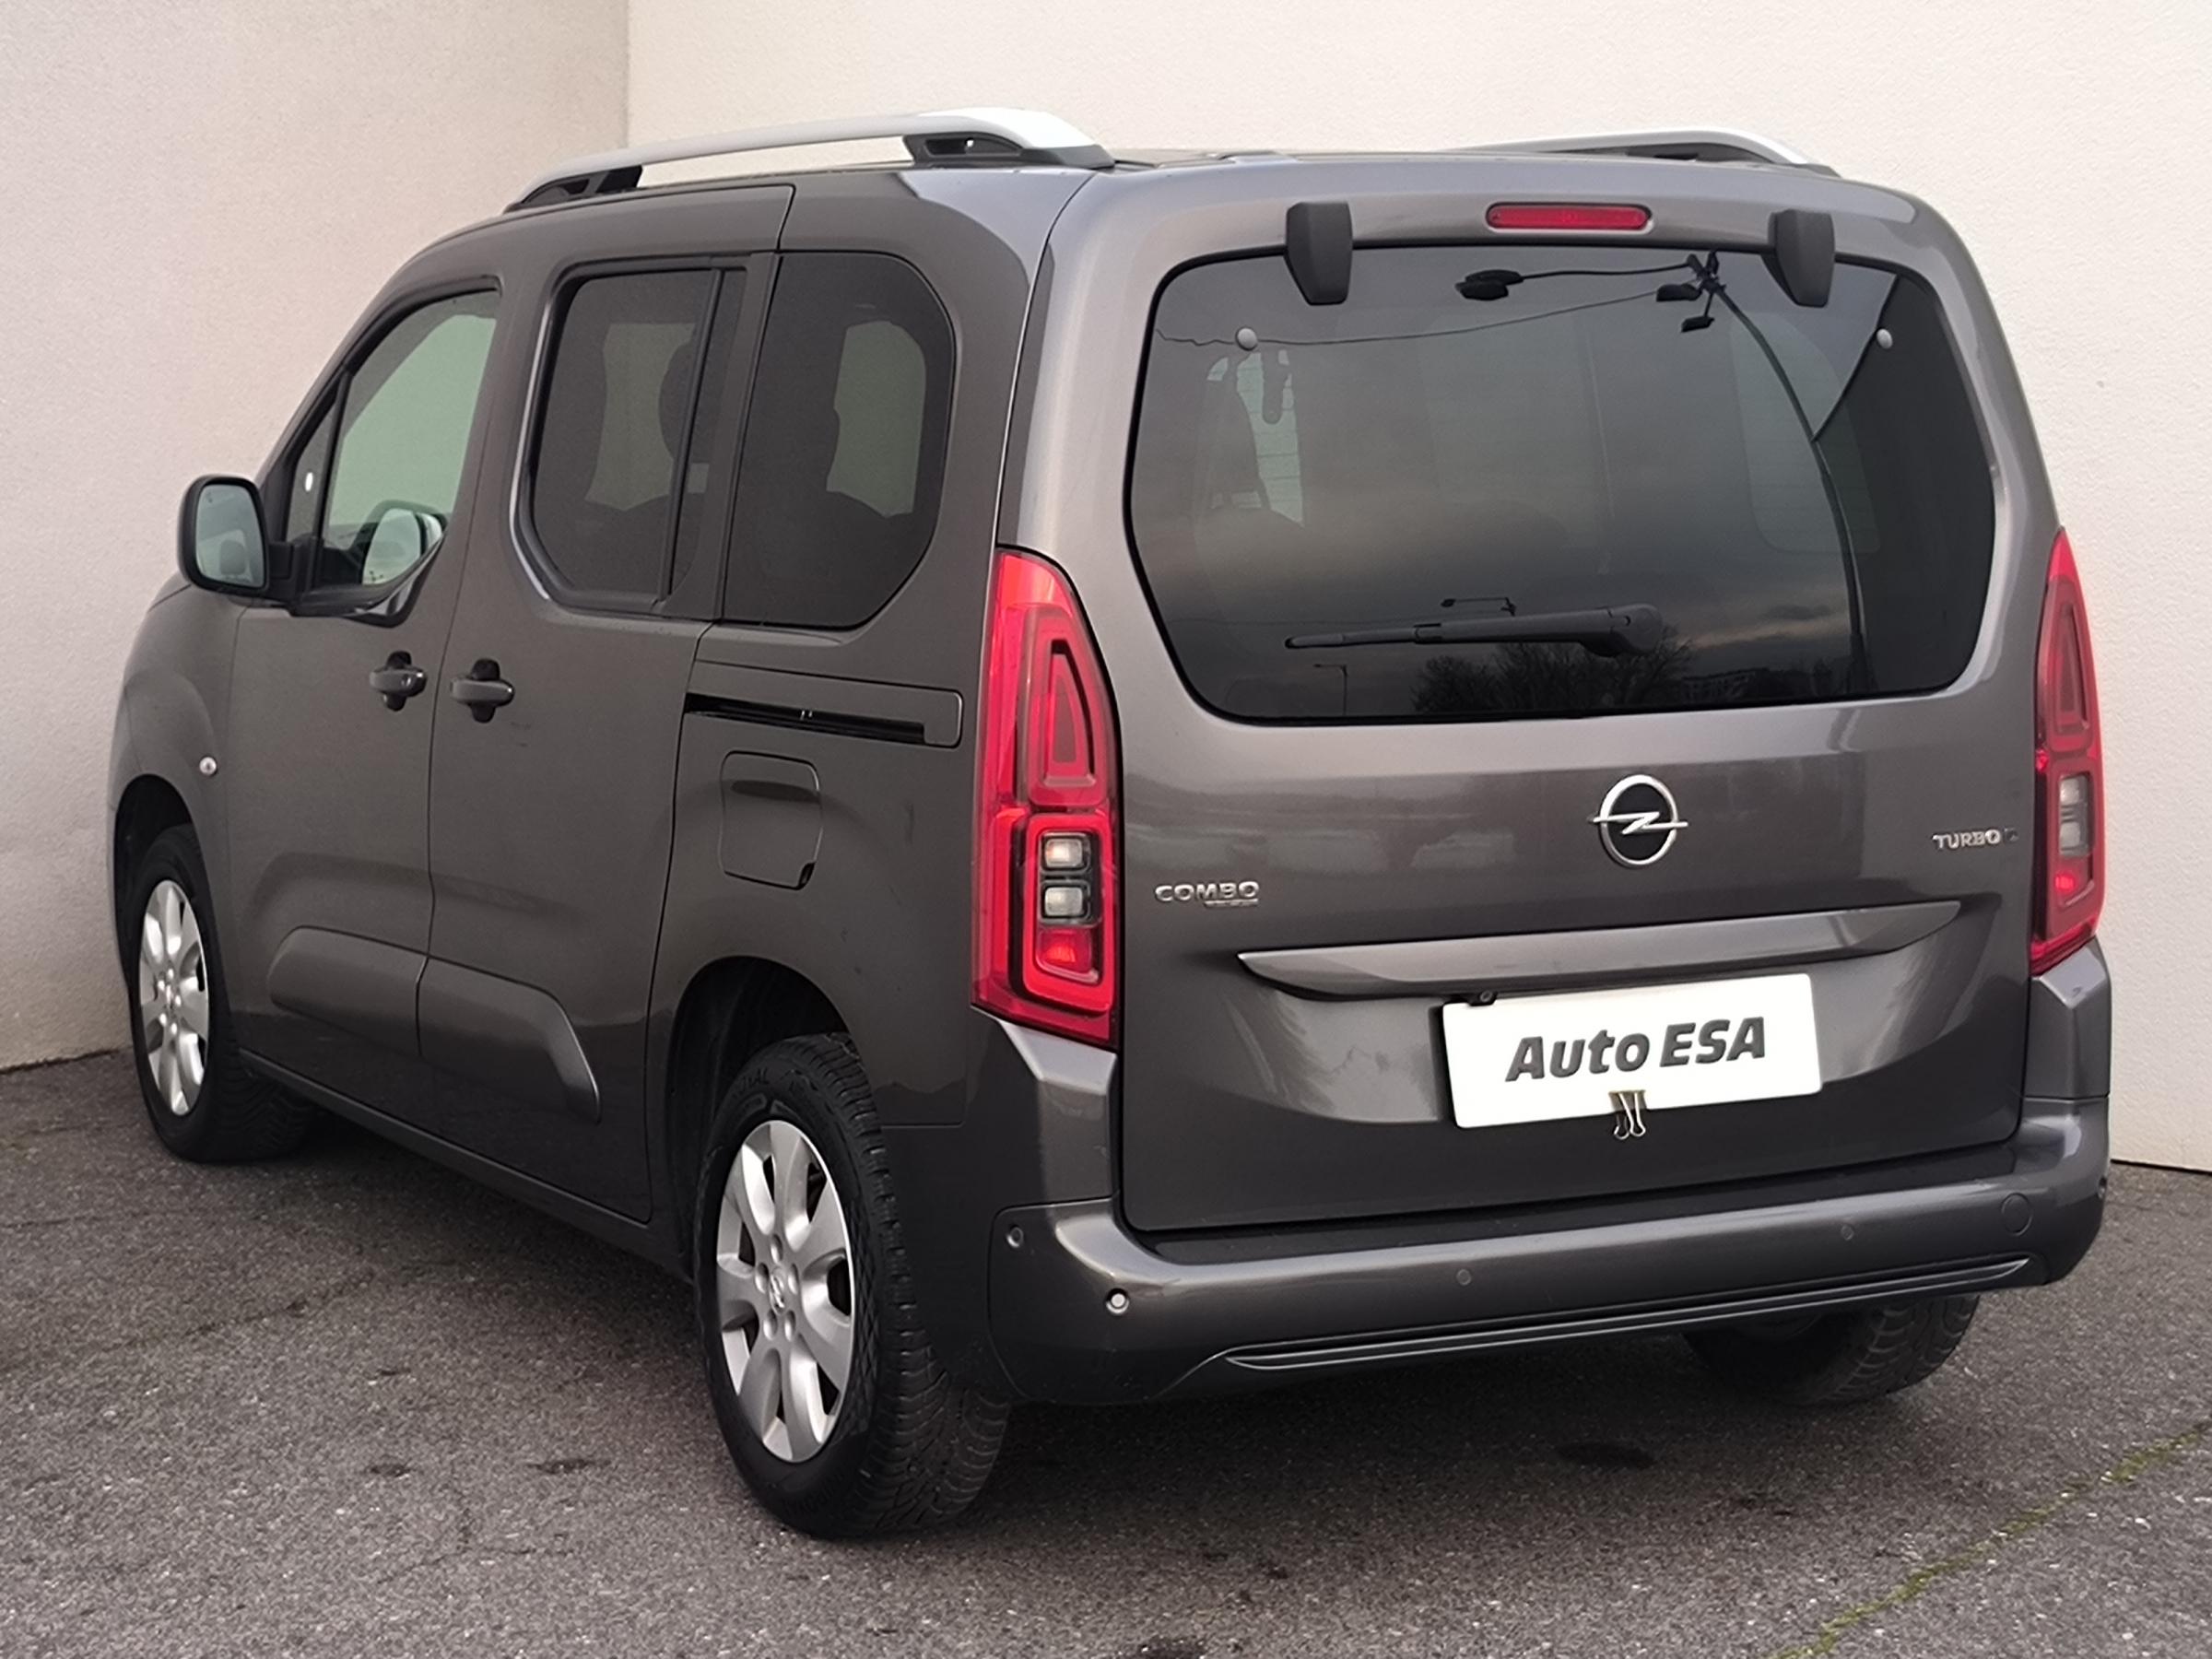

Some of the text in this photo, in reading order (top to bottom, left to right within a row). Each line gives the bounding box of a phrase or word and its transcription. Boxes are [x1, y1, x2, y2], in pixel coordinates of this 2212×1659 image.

[1932, 829, 2002, 849] TURBO
[1154, 881, 1260, 902] COMBO
[1505, 1017, 1766, 1082] Auto ESA
